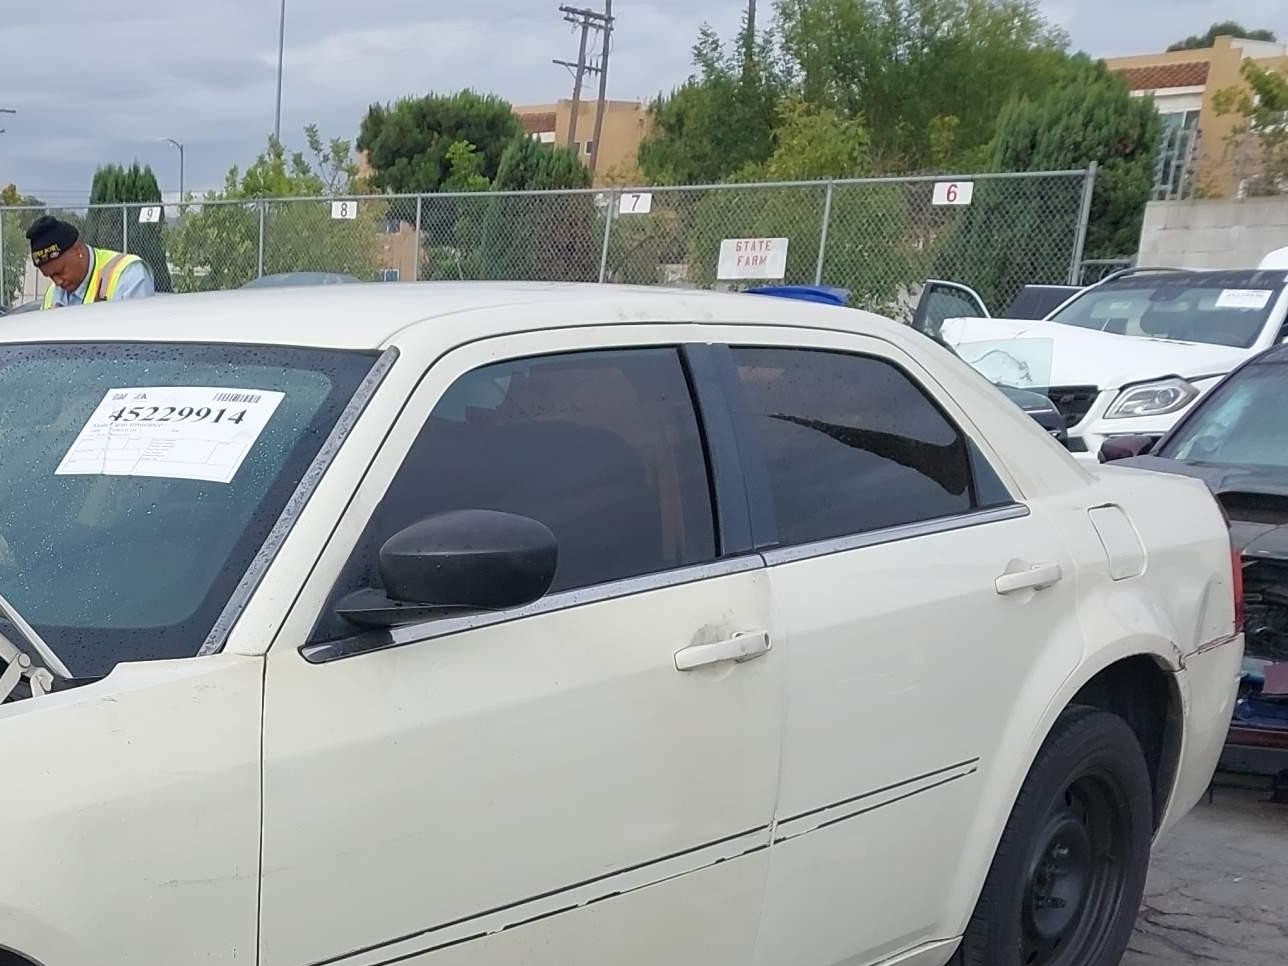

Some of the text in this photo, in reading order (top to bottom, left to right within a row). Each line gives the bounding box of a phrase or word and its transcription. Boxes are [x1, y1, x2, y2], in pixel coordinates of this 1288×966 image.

[946, 183, 958, 203] 6
[340, 202, 348, 217] 8
[631, 194, 641, 211] 7
[146, 208, 153, 221] 9
[736, 240, 772, 252] STATE
[737, 255, 768, 267] FARM
[109, 407, 247, 424] 45229914
